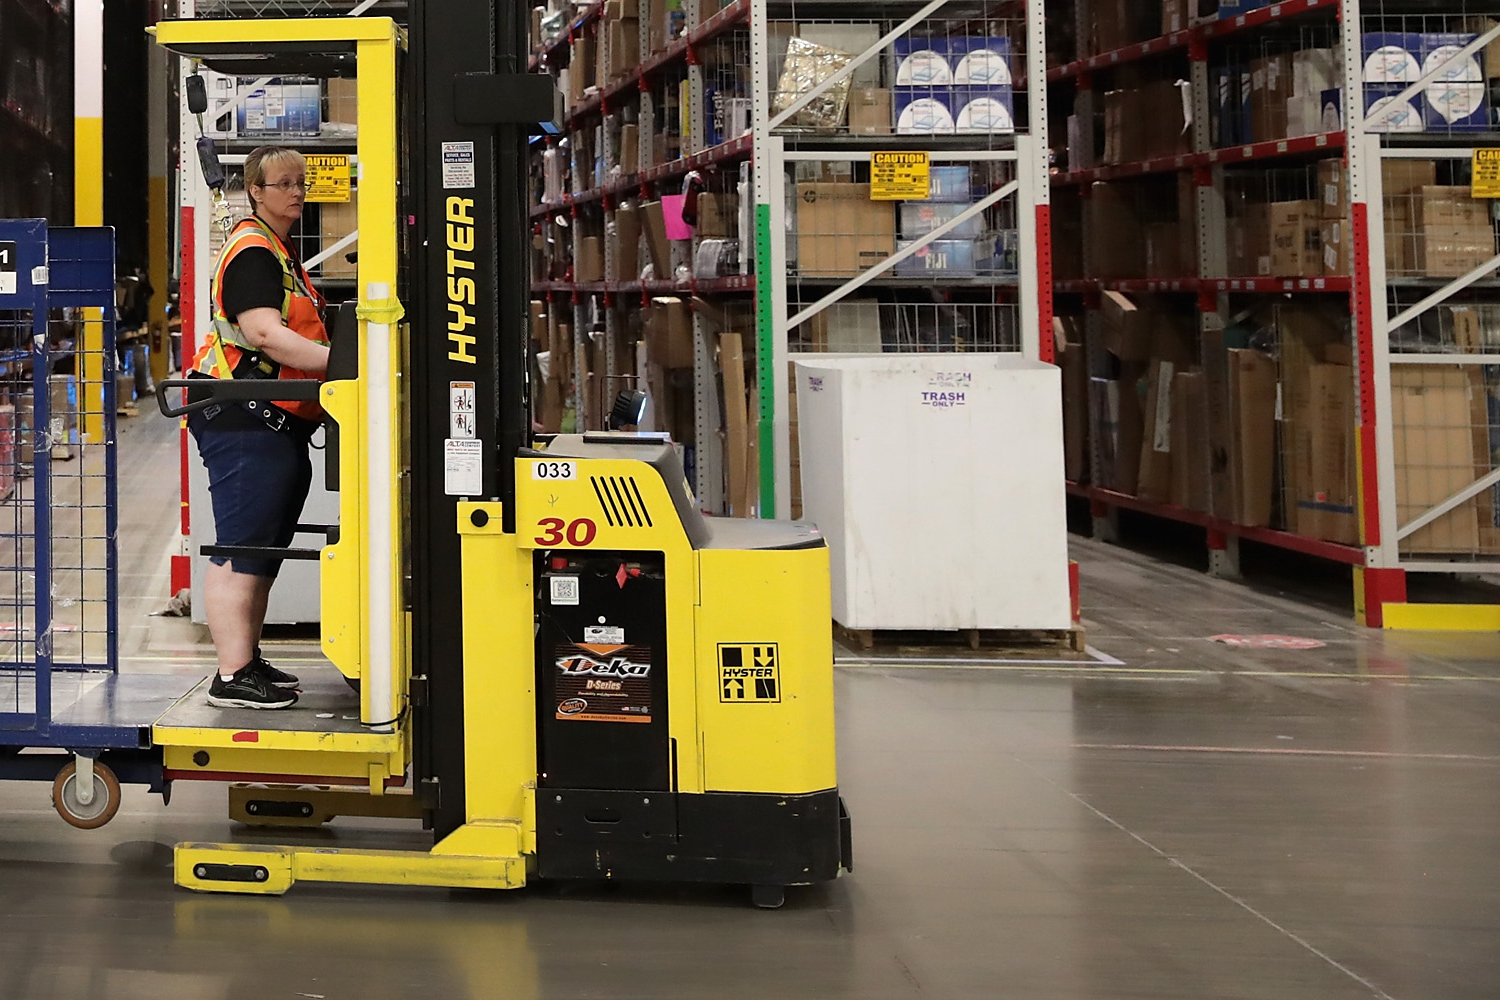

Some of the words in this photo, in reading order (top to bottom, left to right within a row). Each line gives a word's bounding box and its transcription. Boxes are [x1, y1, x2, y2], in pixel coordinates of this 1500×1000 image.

[305, 157, 346, 166] AUTION
[875, 153, 924, 163] CAUTION
[925, 253, 947, 269] FIJI
[446, 196, 477, 364] HYSTER
[921, 392, 965, 401] TRASH
[537, 462, 571, 478] 033
[534, 517, 597, 546] 30
[558, 656, 650, 677] Deka
[723, 668, 773, 677] HYSTER
[585, 679, 622, 690] D-Series
[561, 702, 584, 712] QUALITY
